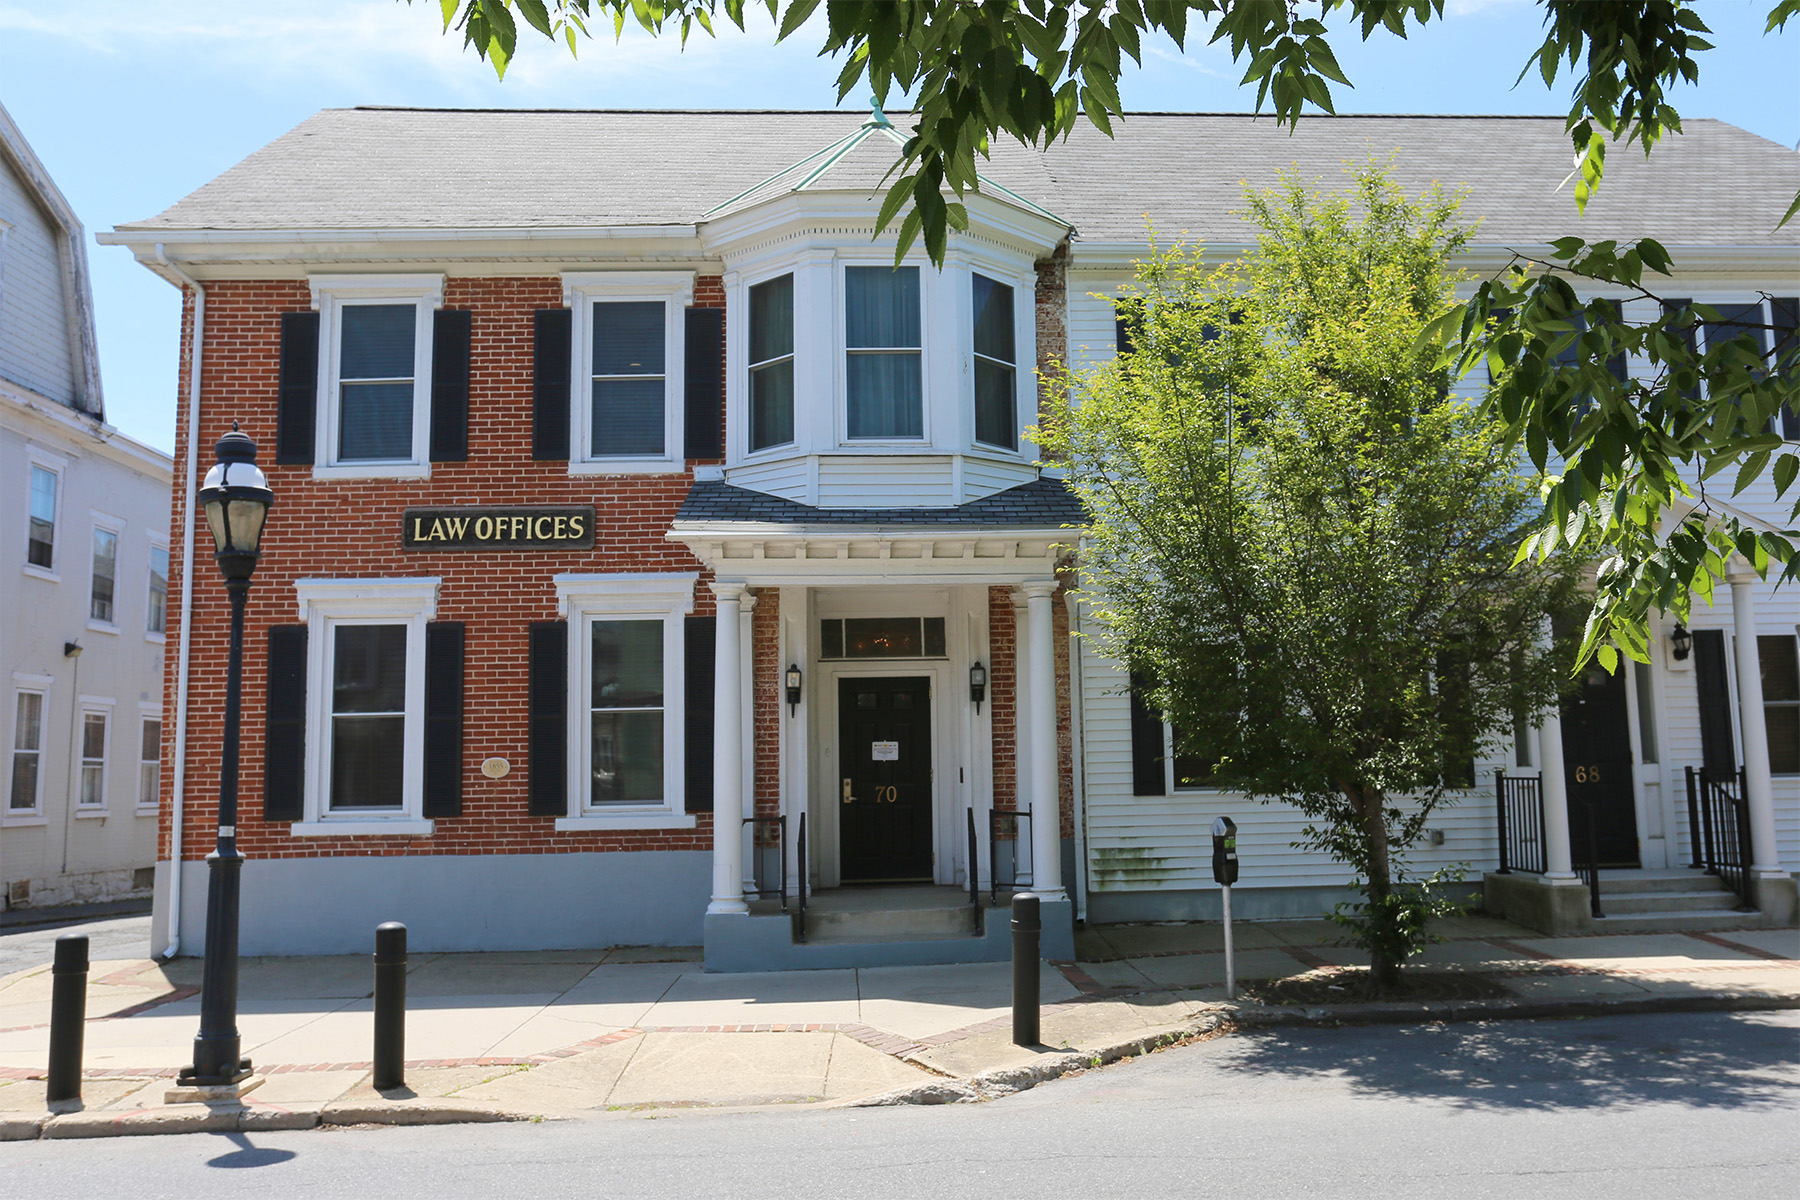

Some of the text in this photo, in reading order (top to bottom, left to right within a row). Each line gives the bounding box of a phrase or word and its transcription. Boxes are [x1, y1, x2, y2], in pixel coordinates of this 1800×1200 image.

[413, 516, 584, 541] LAW OFFICES
[1576, 766, 1600, 783] 68
[875, 786, 897, 803] 70
